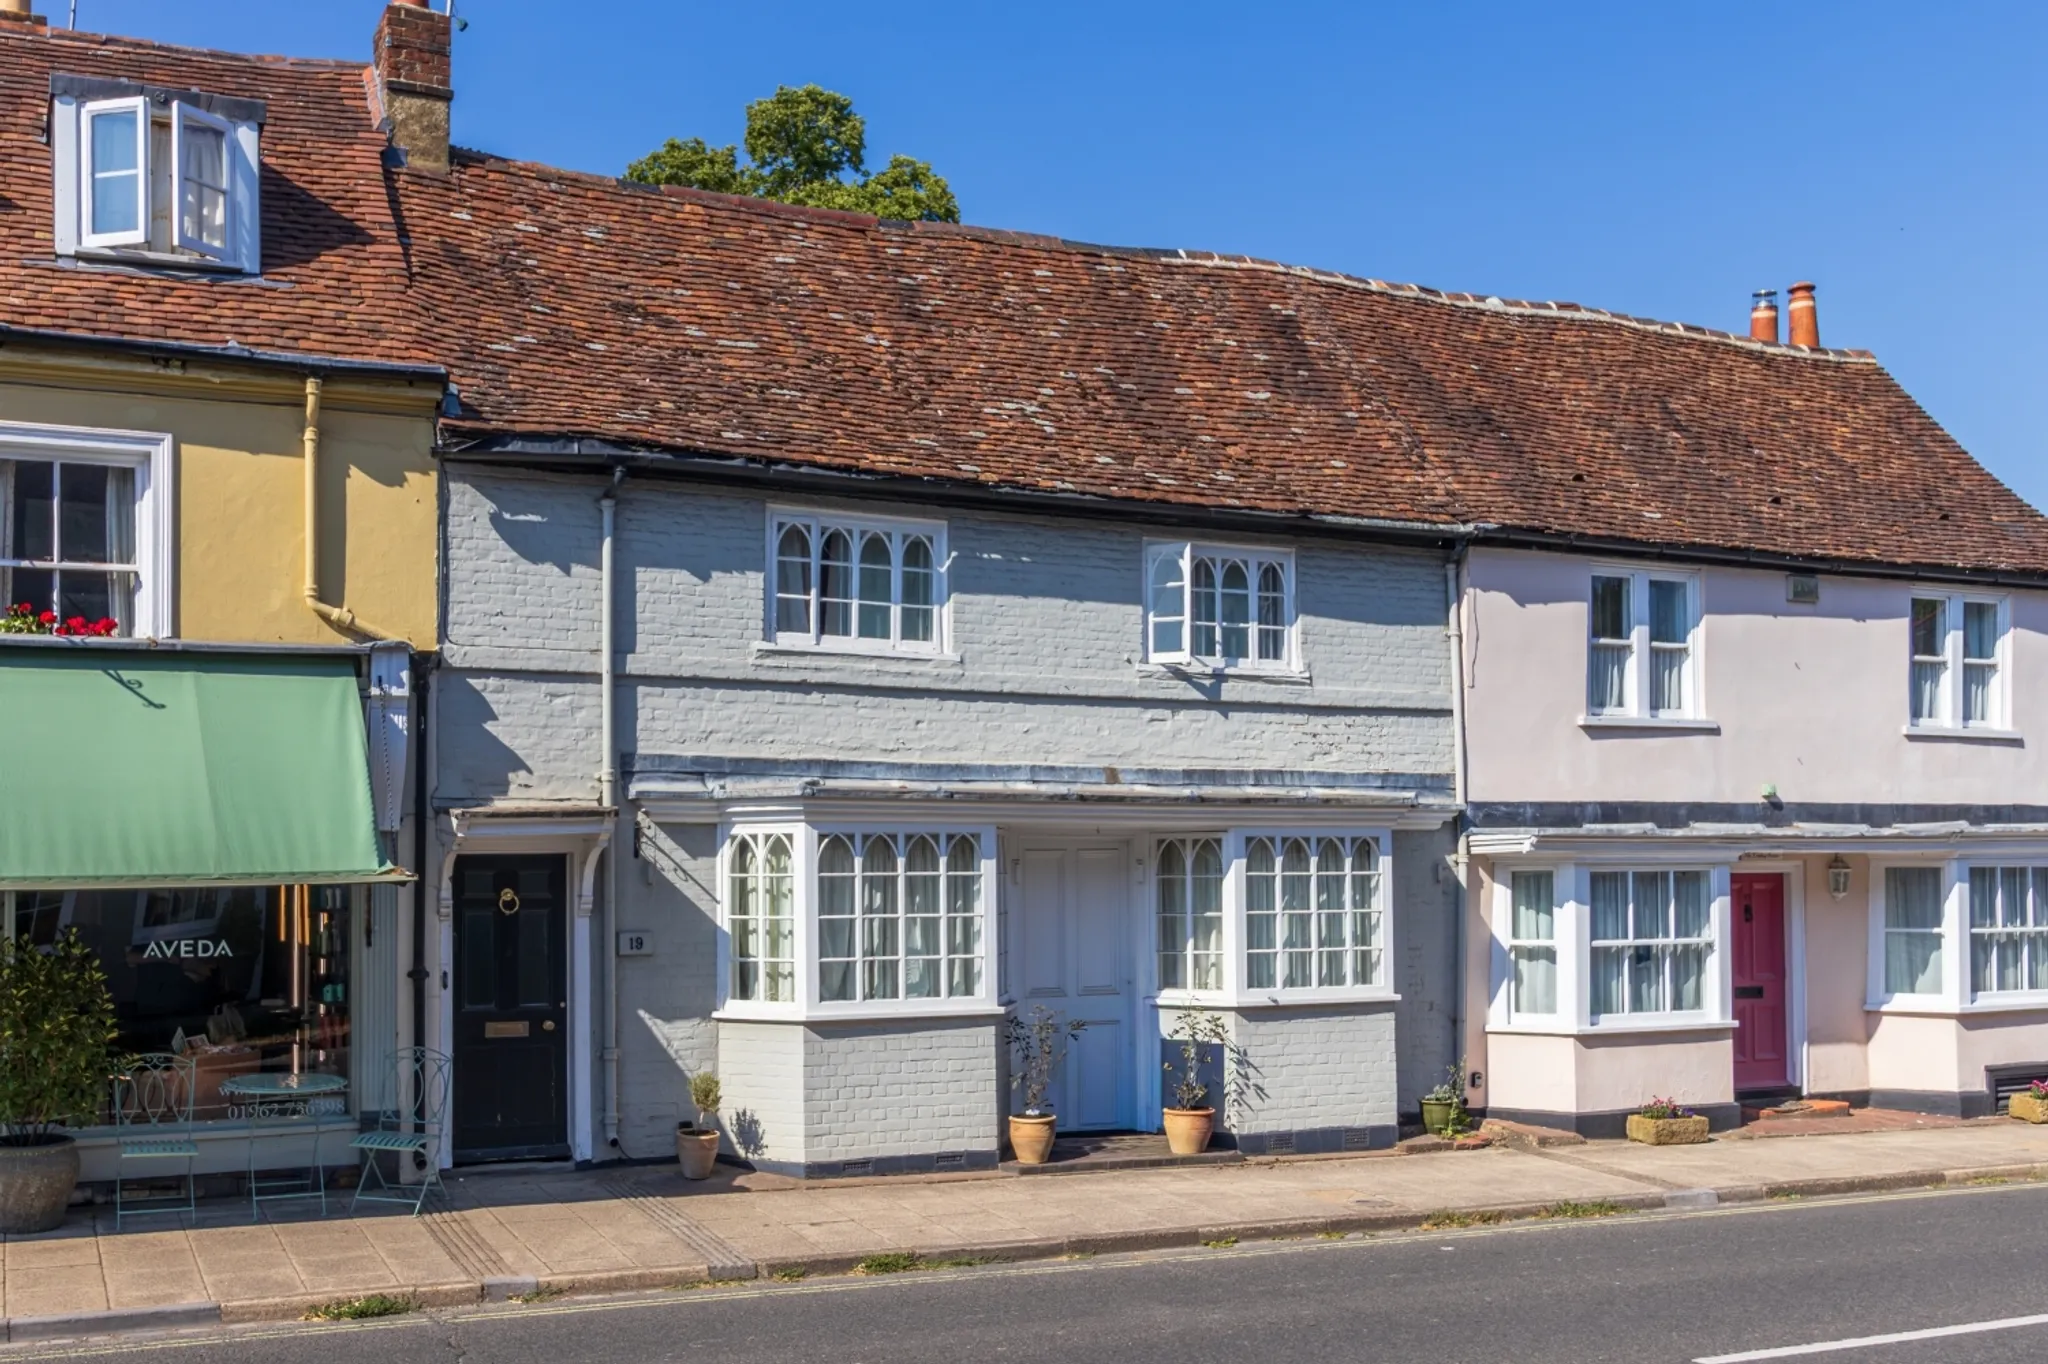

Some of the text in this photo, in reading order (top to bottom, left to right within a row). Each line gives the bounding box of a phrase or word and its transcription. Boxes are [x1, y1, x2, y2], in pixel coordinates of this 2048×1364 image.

[143, 939, 233, 958] AVEDA
[629, 936, 643, 950] 19
[227, 1103, 279, 1120] 01962
